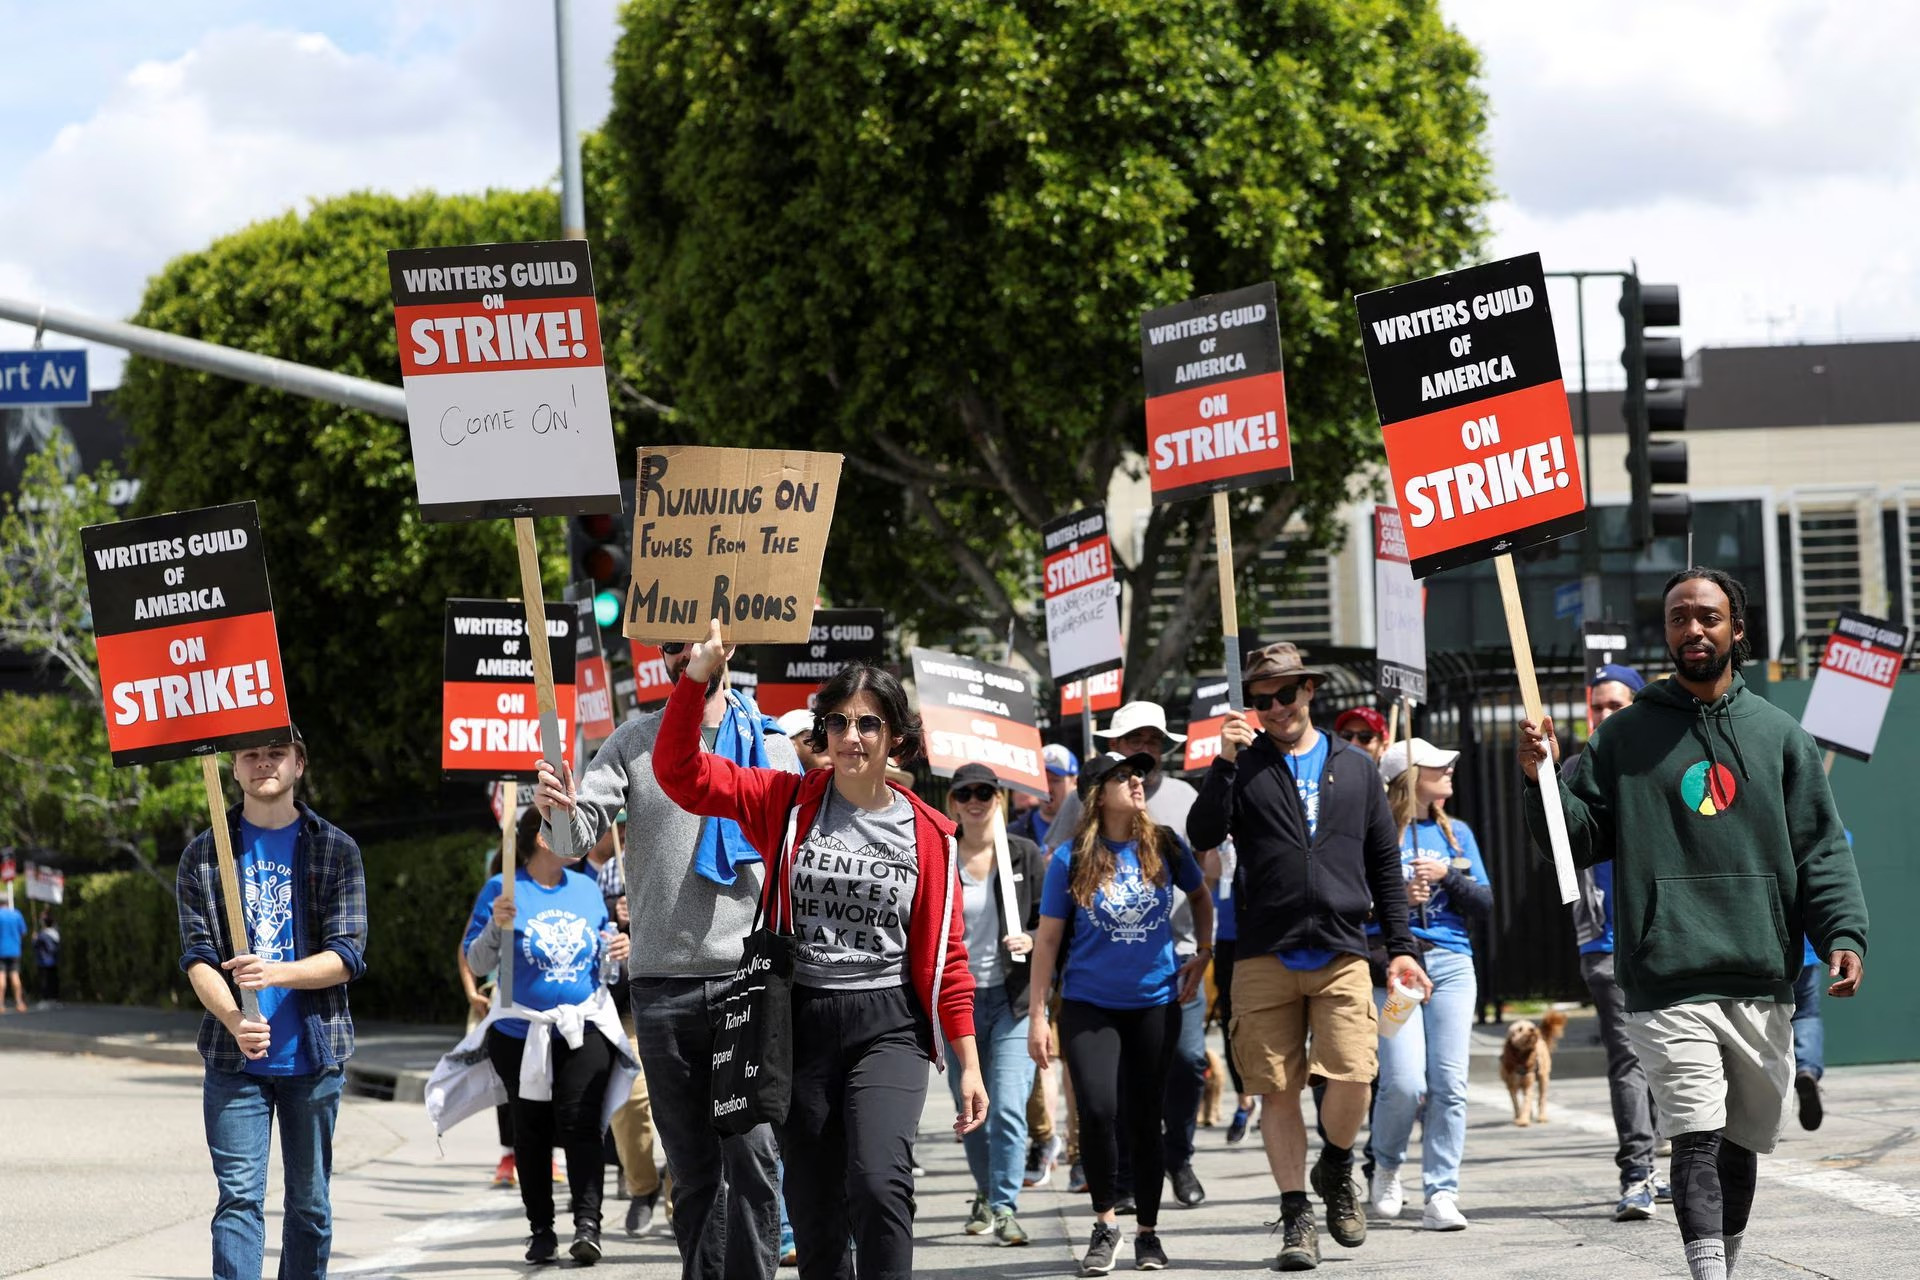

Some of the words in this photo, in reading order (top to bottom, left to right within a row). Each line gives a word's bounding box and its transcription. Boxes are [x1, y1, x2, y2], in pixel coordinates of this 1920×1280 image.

[402, 264, 507, 293] WRITERS
[510, 261, 578, 288] GUILD
[482, 294, 504, 310] ON
[1372, 299, 1470, 346] WRITERS
[1472, 284, 1535, 321] GUILD
[410, 308, 588, 366] STRIKE!
[1149, 313, 1218, 345] WRITERS
[1220, 304, 1266, 330] GUILD
[1199, 337, 1217, 354] OF
[1450, 333, 1473, 358] OF
[40, 361, 77, 390] Av
[1175, 352, 1247, 384] AMERICA
[1421, 354, 1517, 402] AMERICA
[1199, 393, 1228, 419] ON
[1154, 411, 1280, 471] STRIKE!
[1461, 414, 1501, 451] ON
[638, 454, 763, 517] RUNNING
[775, 479, 820, 513] ON
[1404, 435, 1570, 528] STRIKE!
[640, 521, 693, 559] FUMES
[760, 525, 800, 555] THE
[1045, 525, 1079, 550] WRITERS
[1079, 514, 1104, 538] GUILD
[94, 537, 186, 571] WRITERS
[188, 528, 248, 557] GUILD
[163, 566, 185, 587] OF
[1047, 543, 1108, 594] STRIKE!
[134, 586, 226, 621] AMERICA
[629, 578, 699, 625] MINI
[710, 574, 798, 626] ROOMS
[454, 617, 523, 637] WRITERS
[831, 624, 875, 642] GUILD
[169, 636, 207, 666] ON
[503, 640, 520, 655] OF
[810, 644, 828, 659] OF
[1826, 641, 1897, 685] STRIKE!
[475, 658, 535, 677] AMERIC
[920, 659, 985, 685] WRITERS
[984, 672, 1025, 693] GUILD
[1381, 664, 1425, 692] STRIKE
[112, 659, 275, 726] STRIKE!
[497, 693, 524, 714] ON
[947, 691, 1011, 717] AMERICA
[967, 682, 985, 696] OF
[449, 717, 567, 753] STRIK!
[930, 729, 1040, 777] STRIKE!
[277, 864, 293, 877] OF
[794, 872, 899, 906] MAKES
[824, 900, 899, 929] WORLD
[798, 923, 884, 953] TAKES
[744, 1060, 759, 1079] for
